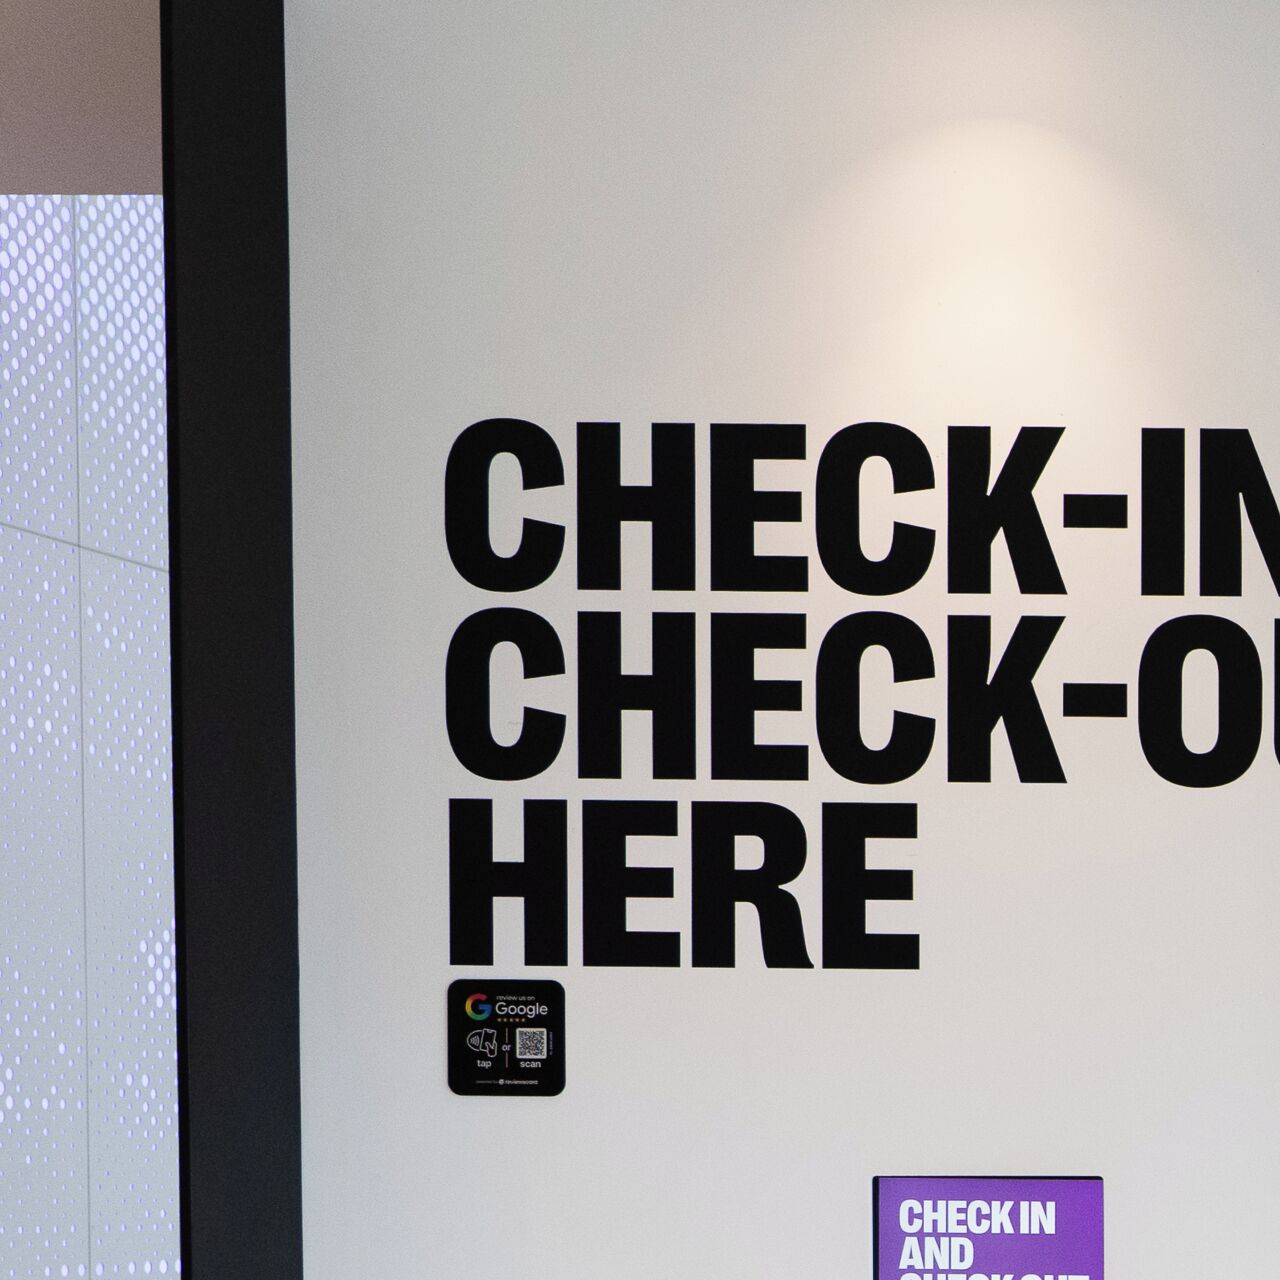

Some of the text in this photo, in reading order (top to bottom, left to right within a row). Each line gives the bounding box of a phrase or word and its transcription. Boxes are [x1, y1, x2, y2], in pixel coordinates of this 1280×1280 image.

[448, 798, 921, 970] HERE
[495, 1002, 548, 1019] Google
[477, 1059, 492, 1069] tap
[519, 1060, 542, 1068] scan
[899, 1199, 1056, 1235] CHECK IN
[898, 1236, 975, 1270] AND
